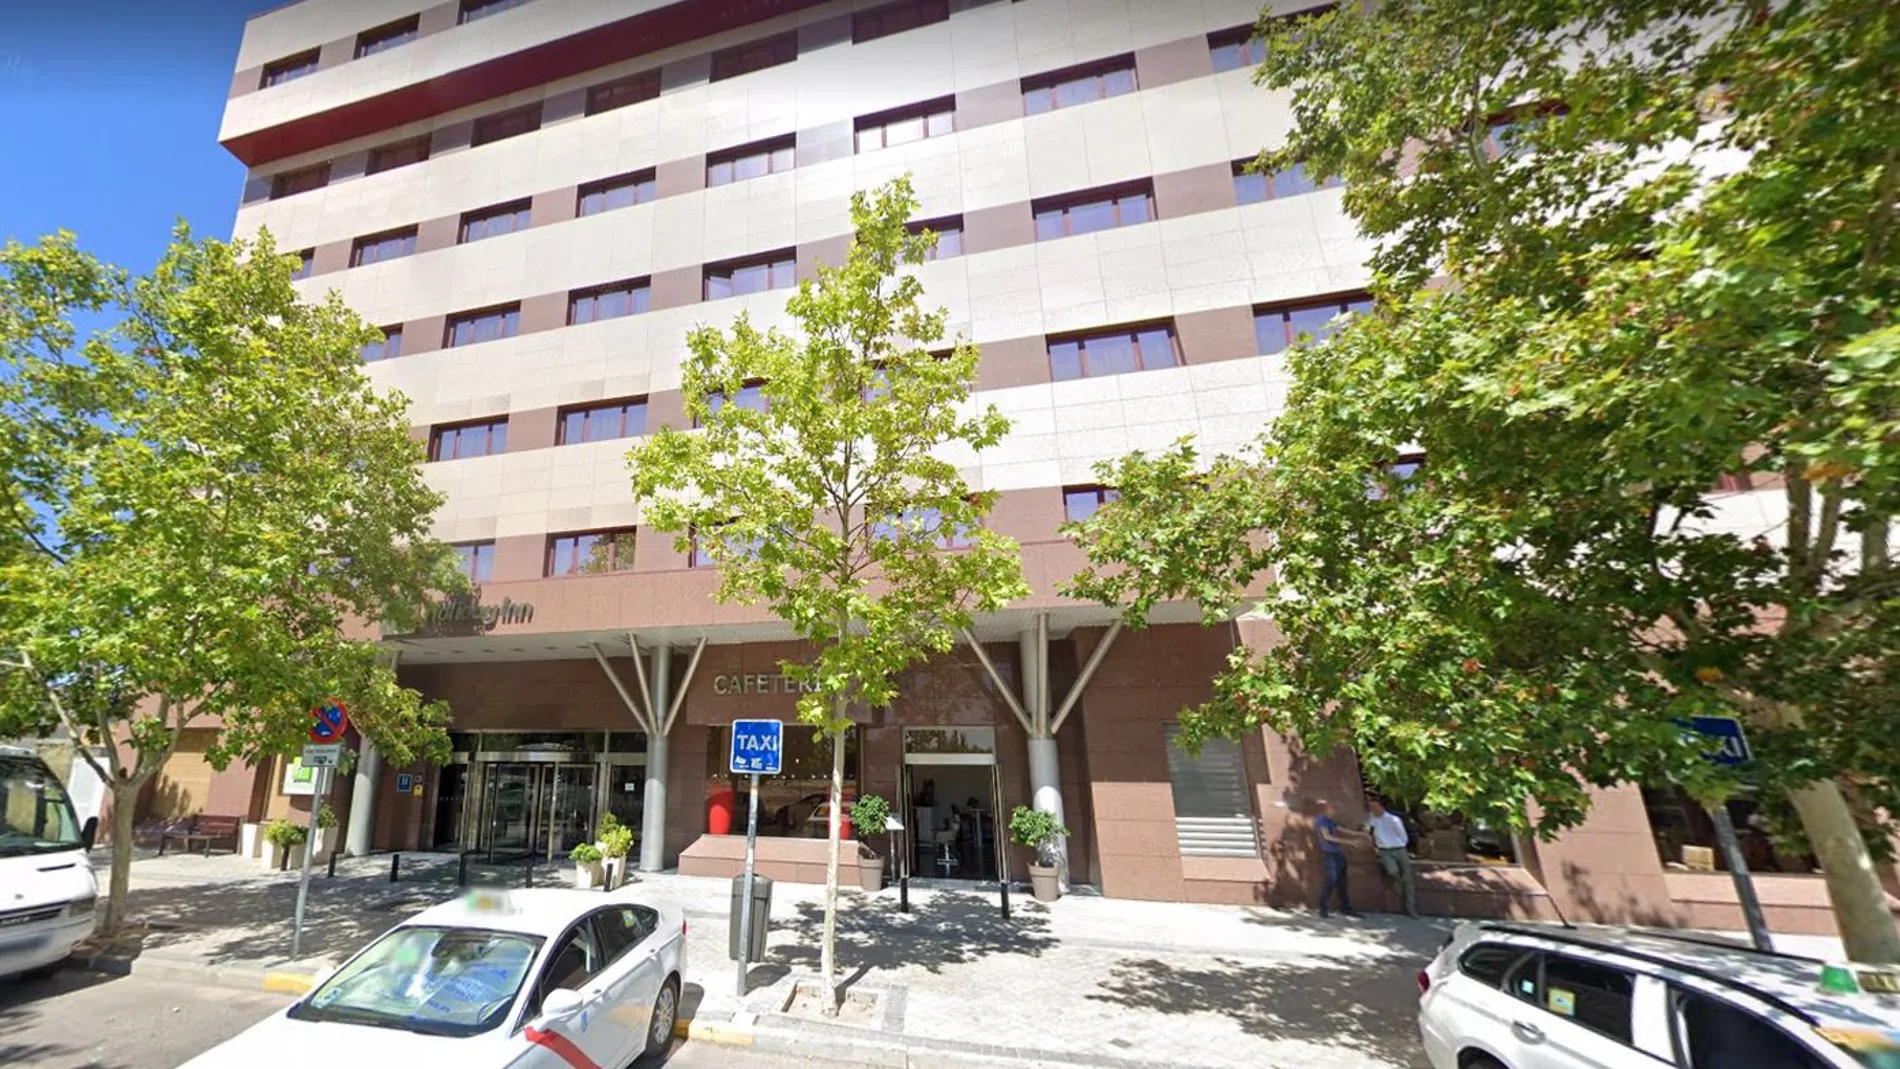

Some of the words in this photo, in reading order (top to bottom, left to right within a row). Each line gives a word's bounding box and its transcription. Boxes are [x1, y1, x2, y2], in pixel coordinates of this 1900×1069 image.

[501, 597, 534, 624] Inn
[713, 674, 825, 694] CAFETERI
[736, 734, 778, 751] TAXI
